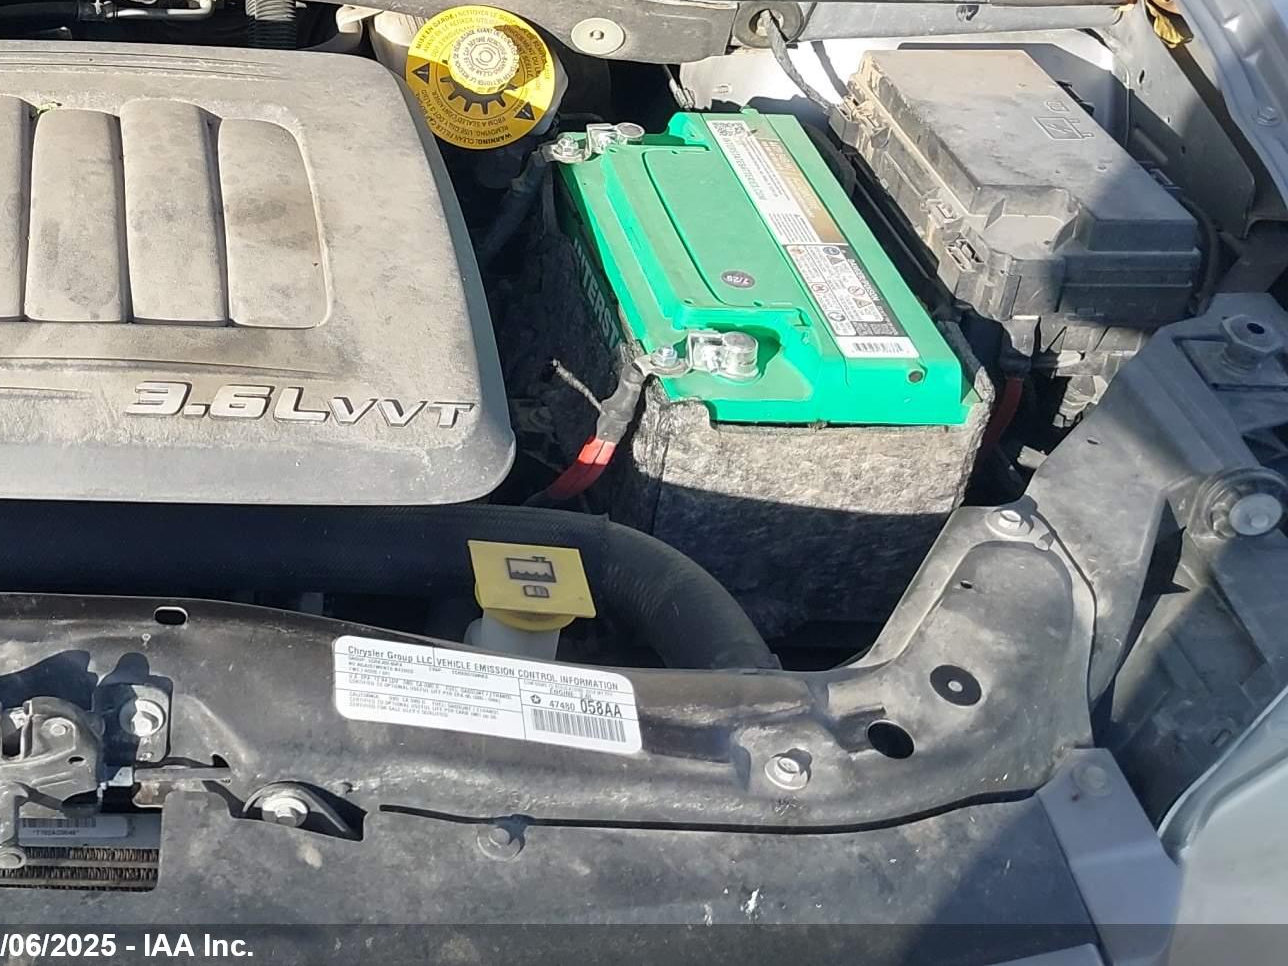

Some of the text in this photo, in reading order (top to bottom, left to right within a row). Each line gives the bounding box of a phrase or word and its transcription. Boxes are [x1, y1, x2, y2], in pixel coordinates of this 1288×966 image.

[348, 646, 384, 657] Chrysler
[387, 651, 413, 663] Group
[417, 655, 432, 665] LLC
[436, 658, 471, 670] VEHICLE
[474, 663, 515, 676] EMISSION
[518, 669, 557, 682] CONTROL
[560, 675, 618, 690] INFORMATION
[581, 699, 622, 718] 058AA
